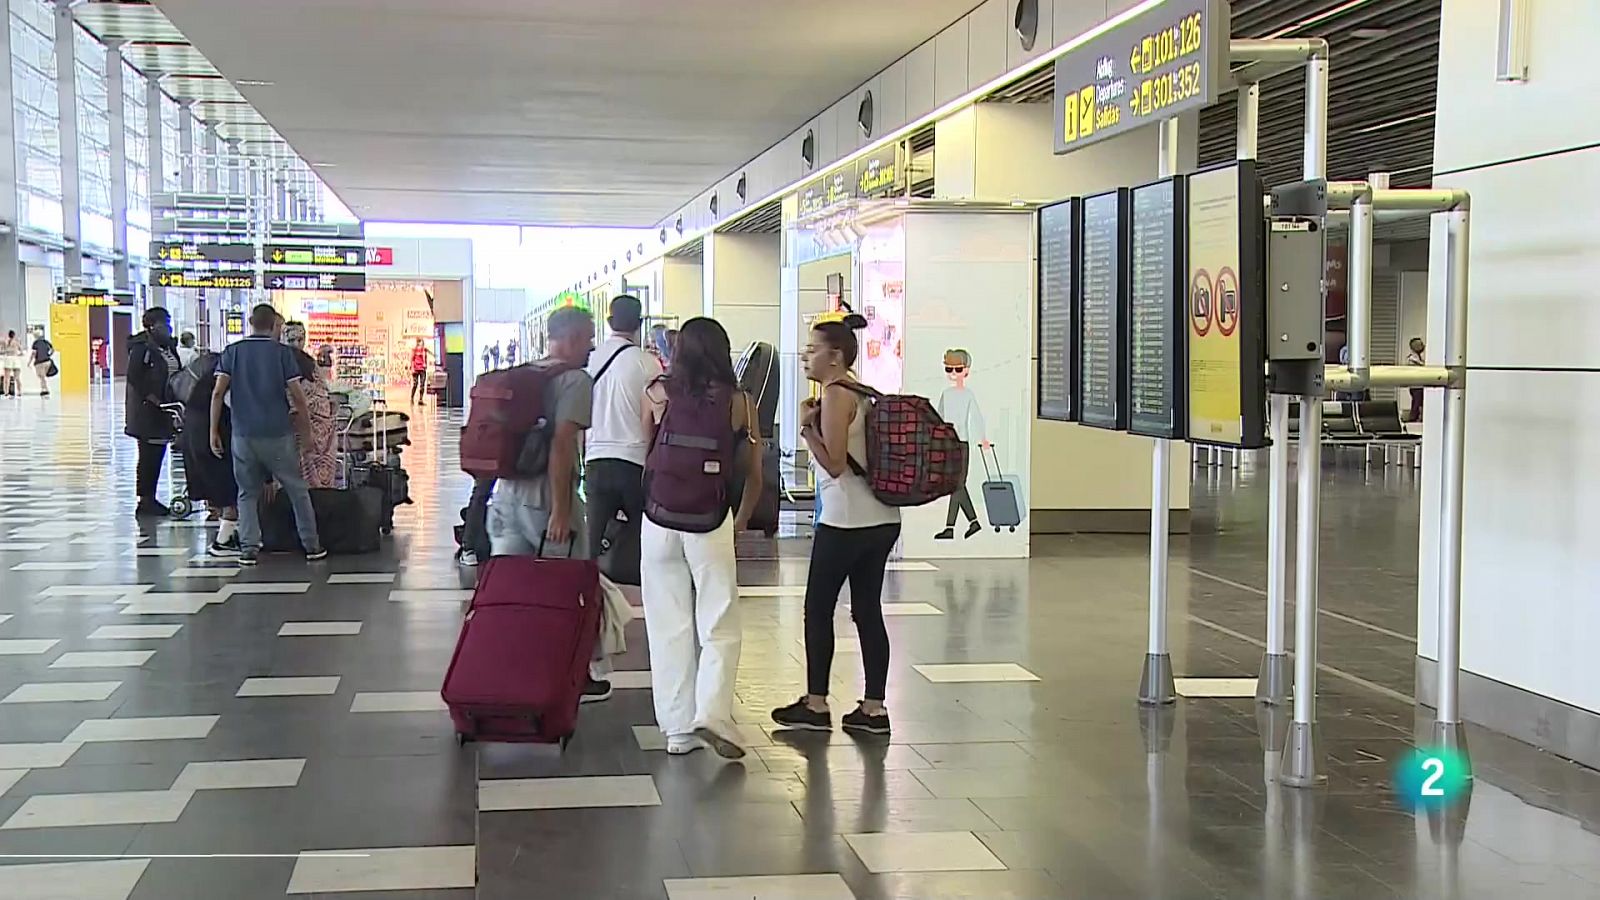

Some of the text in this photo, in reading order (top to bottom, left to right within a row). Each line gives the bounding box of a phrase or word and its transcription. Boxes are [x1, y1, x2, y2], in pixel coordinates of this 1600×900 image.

[1154, 27, 1173, 66] 101
[1180, 12, 1201, 56] 126
[1153, 71, 1173, 109] 301
[1178, 62, 1200, 100] 352
[1096, 104, 1120, 129] Salidas
